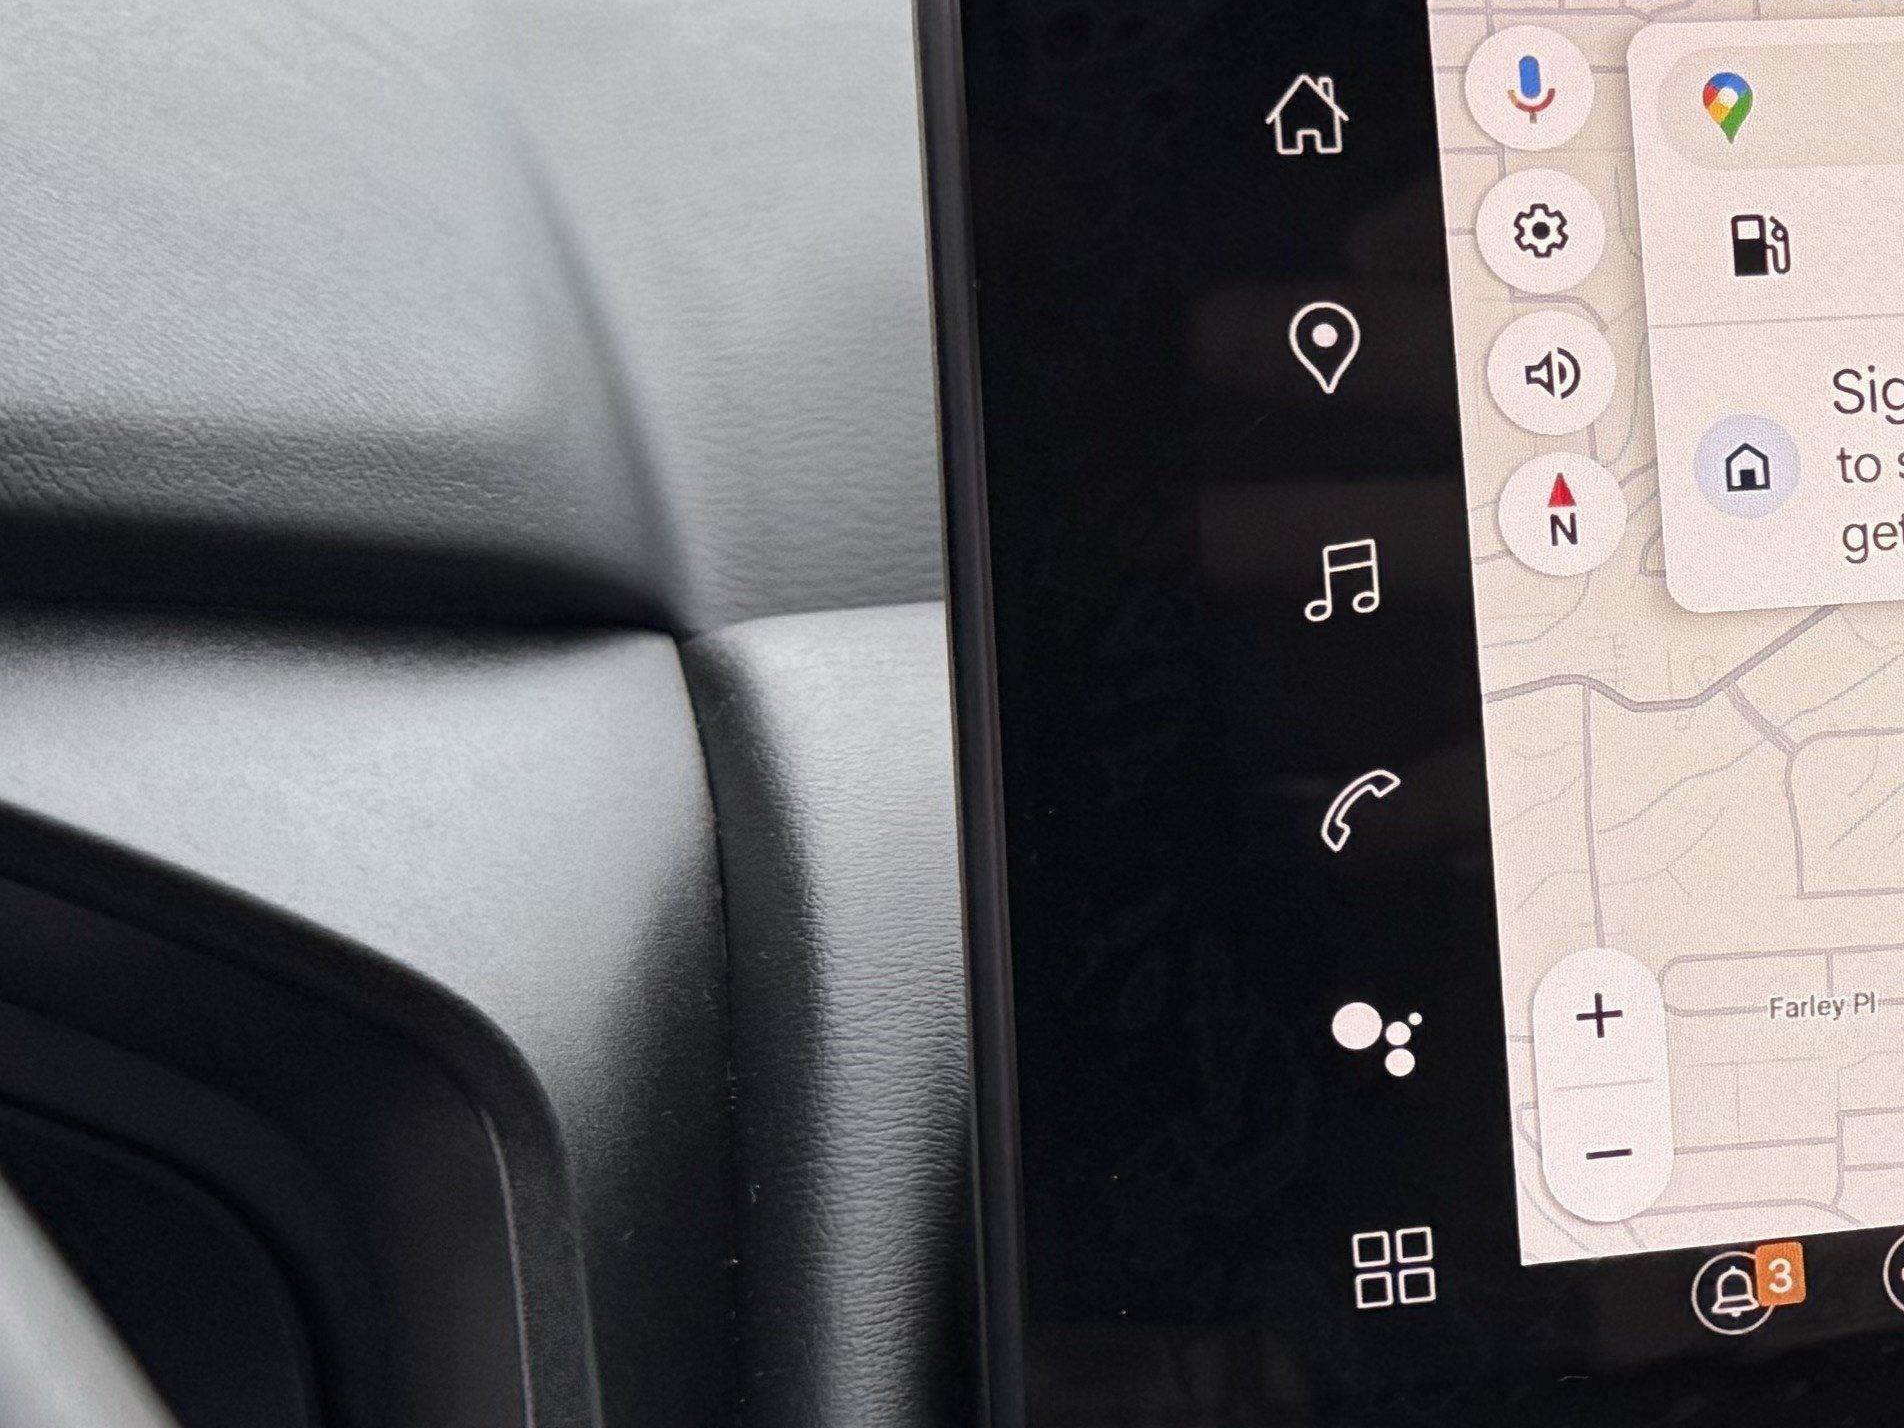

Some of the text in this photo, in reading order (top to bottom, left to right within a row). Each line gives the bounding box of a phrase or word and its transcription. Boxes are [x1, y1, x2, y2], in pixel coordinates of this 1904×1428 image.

[1837, 447, 1882, 484] to
[1550, 513, 1579, 546] N
[1769, 992, 1876, 1021] Farley Pl
[1768, 1260, 1794, 1294] 3
